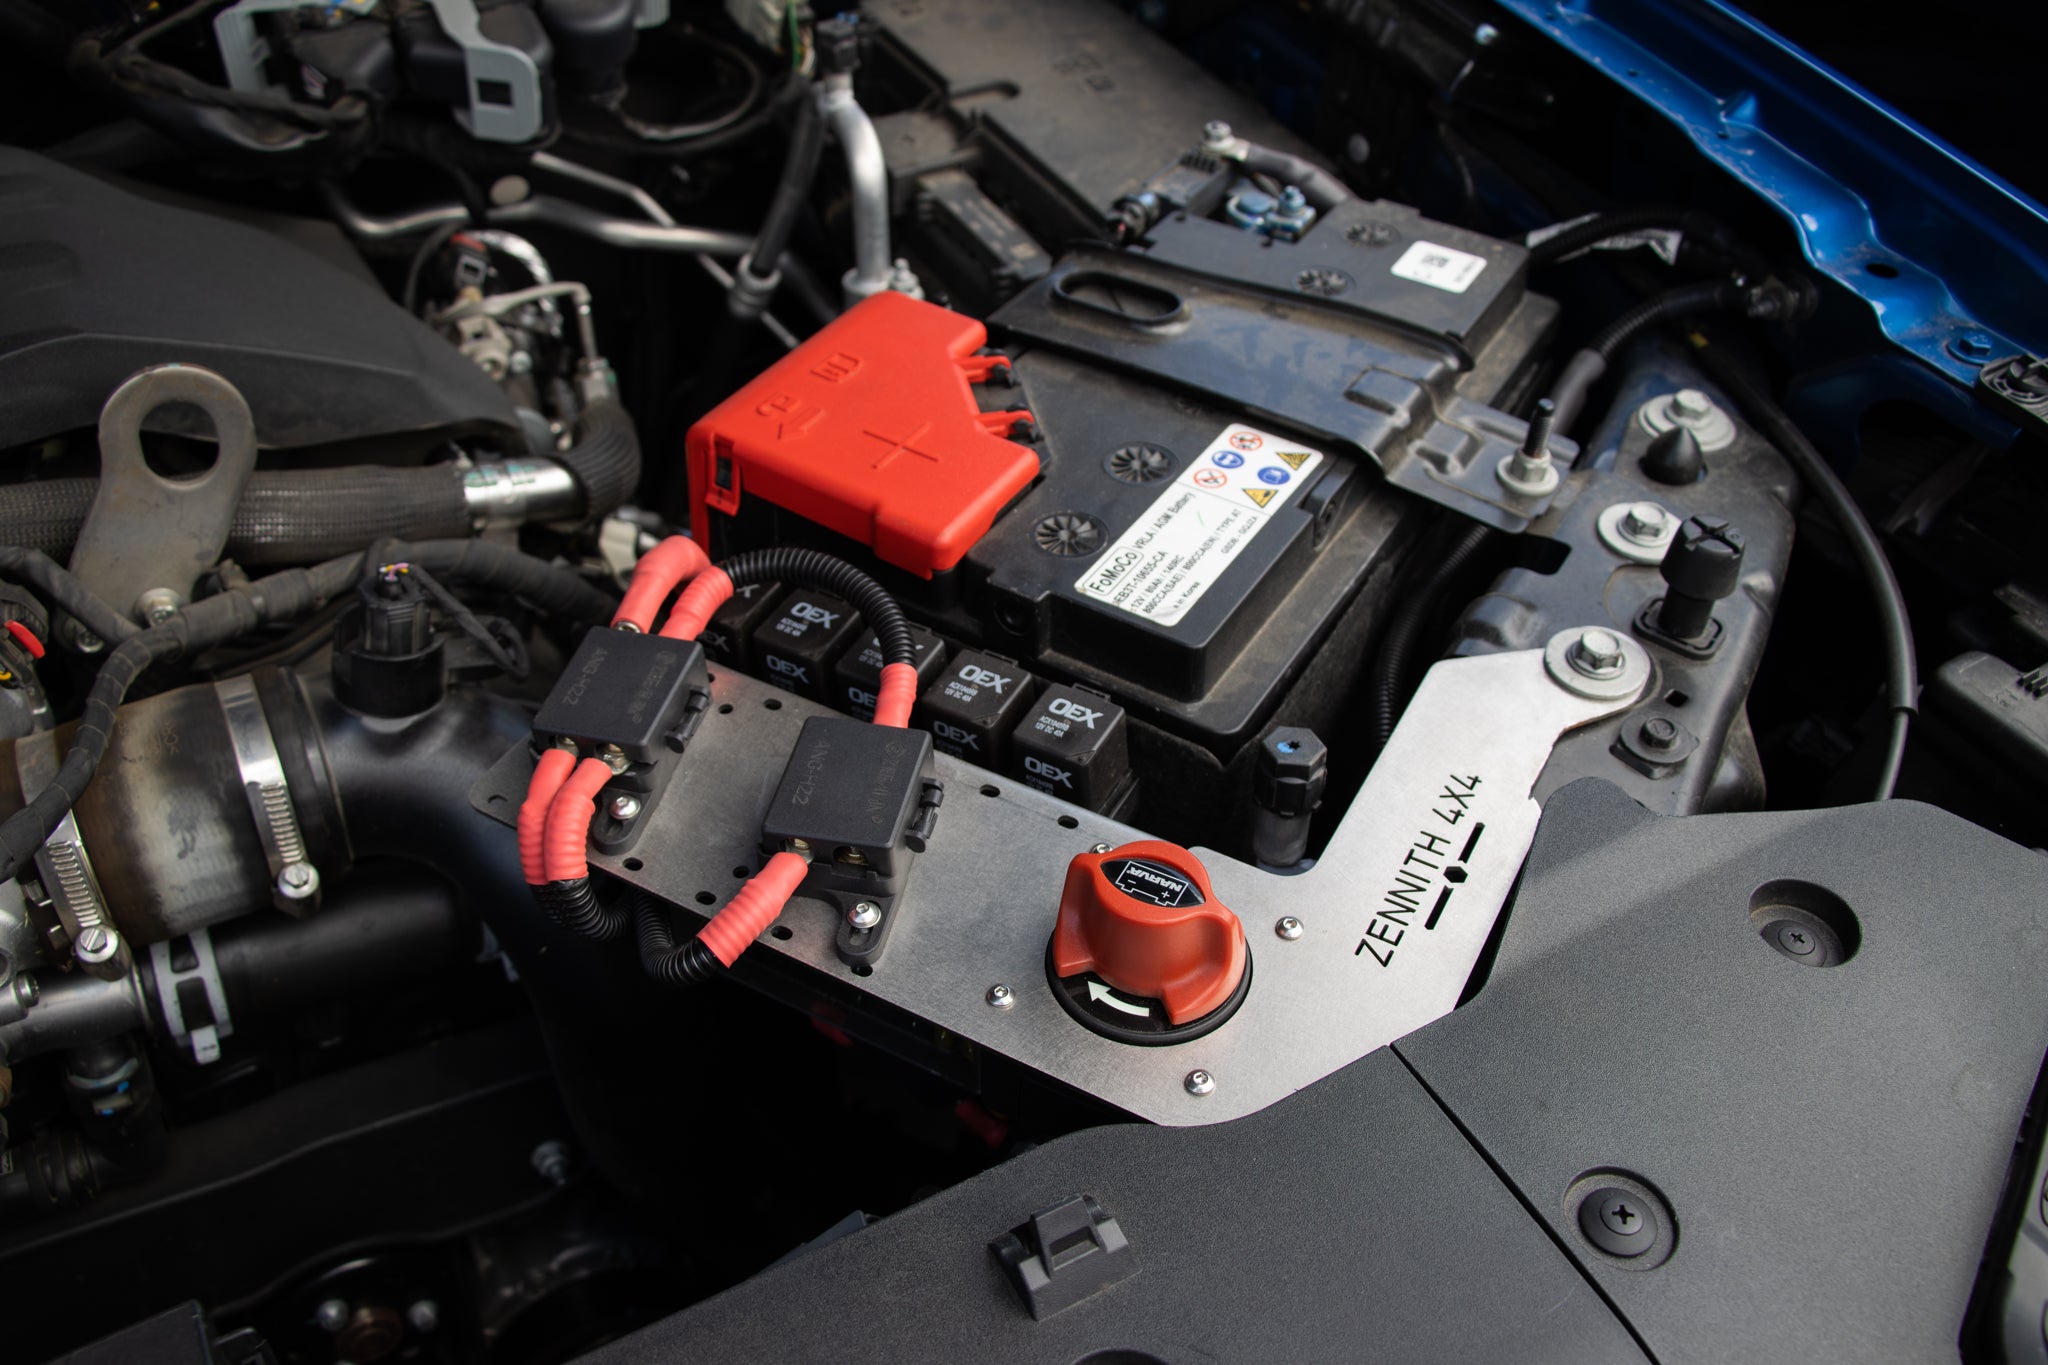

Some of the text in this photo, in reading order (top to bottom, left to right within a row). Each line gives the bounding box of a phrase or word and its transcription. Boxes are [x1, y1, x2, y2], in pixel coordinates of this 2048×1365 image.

[1133, 531, 1154, 549] VRLA
[1154, 512, 1172, 527] AGM
[1168, 491, 1195, 513] Battery
[1089, 550, 1138, 592] FoMoCo
[1181, 580, 1199, 597] Korea
[790, 601, 840, 629] OEX
[766, 654, 810, 685] OEX
[958, 664, 1012, 694] OEX
[848, 687, 877, 708] OE
[1048, 698, 1105, 729] OEX
[933, 720, 980, 752] OEX
[1024, 756, 1073, 790] OEX
[1127, 867, 1183, 892] NARVA
[1354, 774, 1483, 968] ZENNITH 4X4
